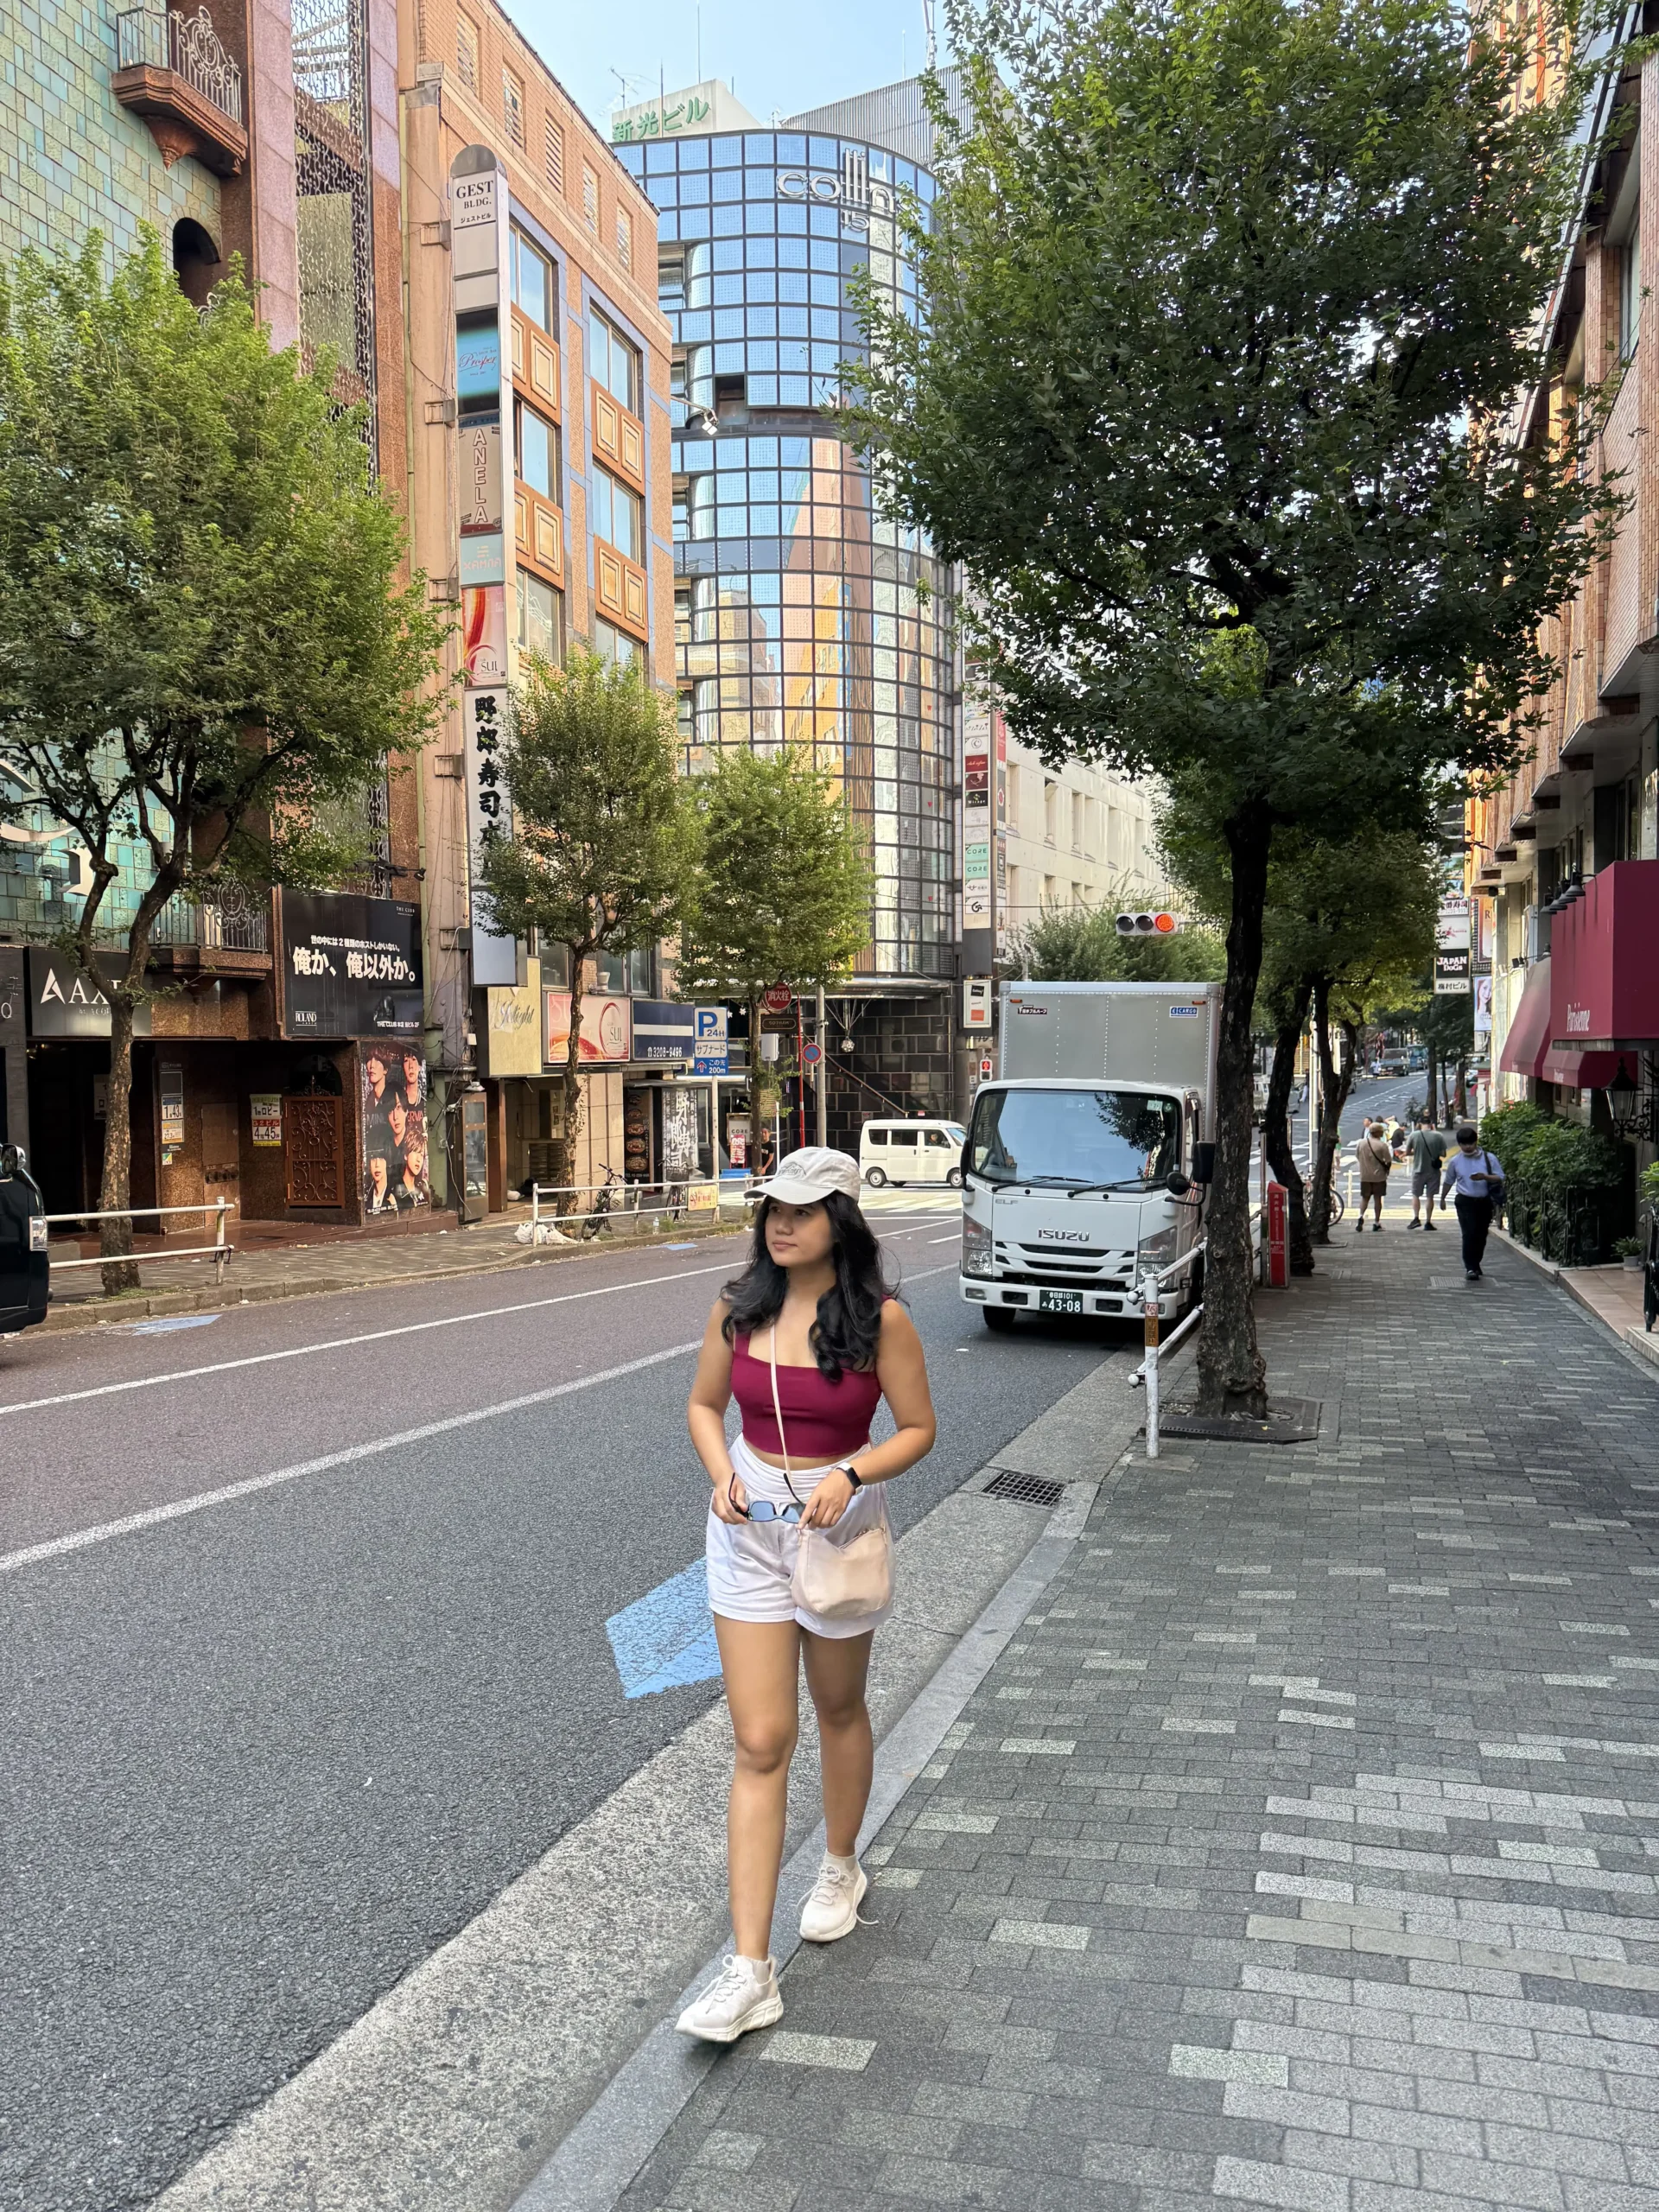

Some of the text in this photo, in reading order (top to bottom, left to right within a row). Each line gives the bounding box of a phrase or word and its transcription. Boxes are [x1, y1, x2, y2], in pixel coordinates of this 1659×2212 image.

[613, 97, 709, 142] 新光ビル
[456, 180, 494, 199] GEST
[464, 198, 492, 209] BLDG.
[461, 213, 492, 224] ジェストビル
[841, 210, 869, 231] 15
[473, 428, 488, 524] ANELA
[1437, 957, 1467, 965] JAPAN
[767, 990, 790, 1001] 消火栓
[698, 1011, 718, 1037] P
[1038, 1228, 1090, 1242] ISUZU
[1048, 1299, 1081, 1313] 43-08
